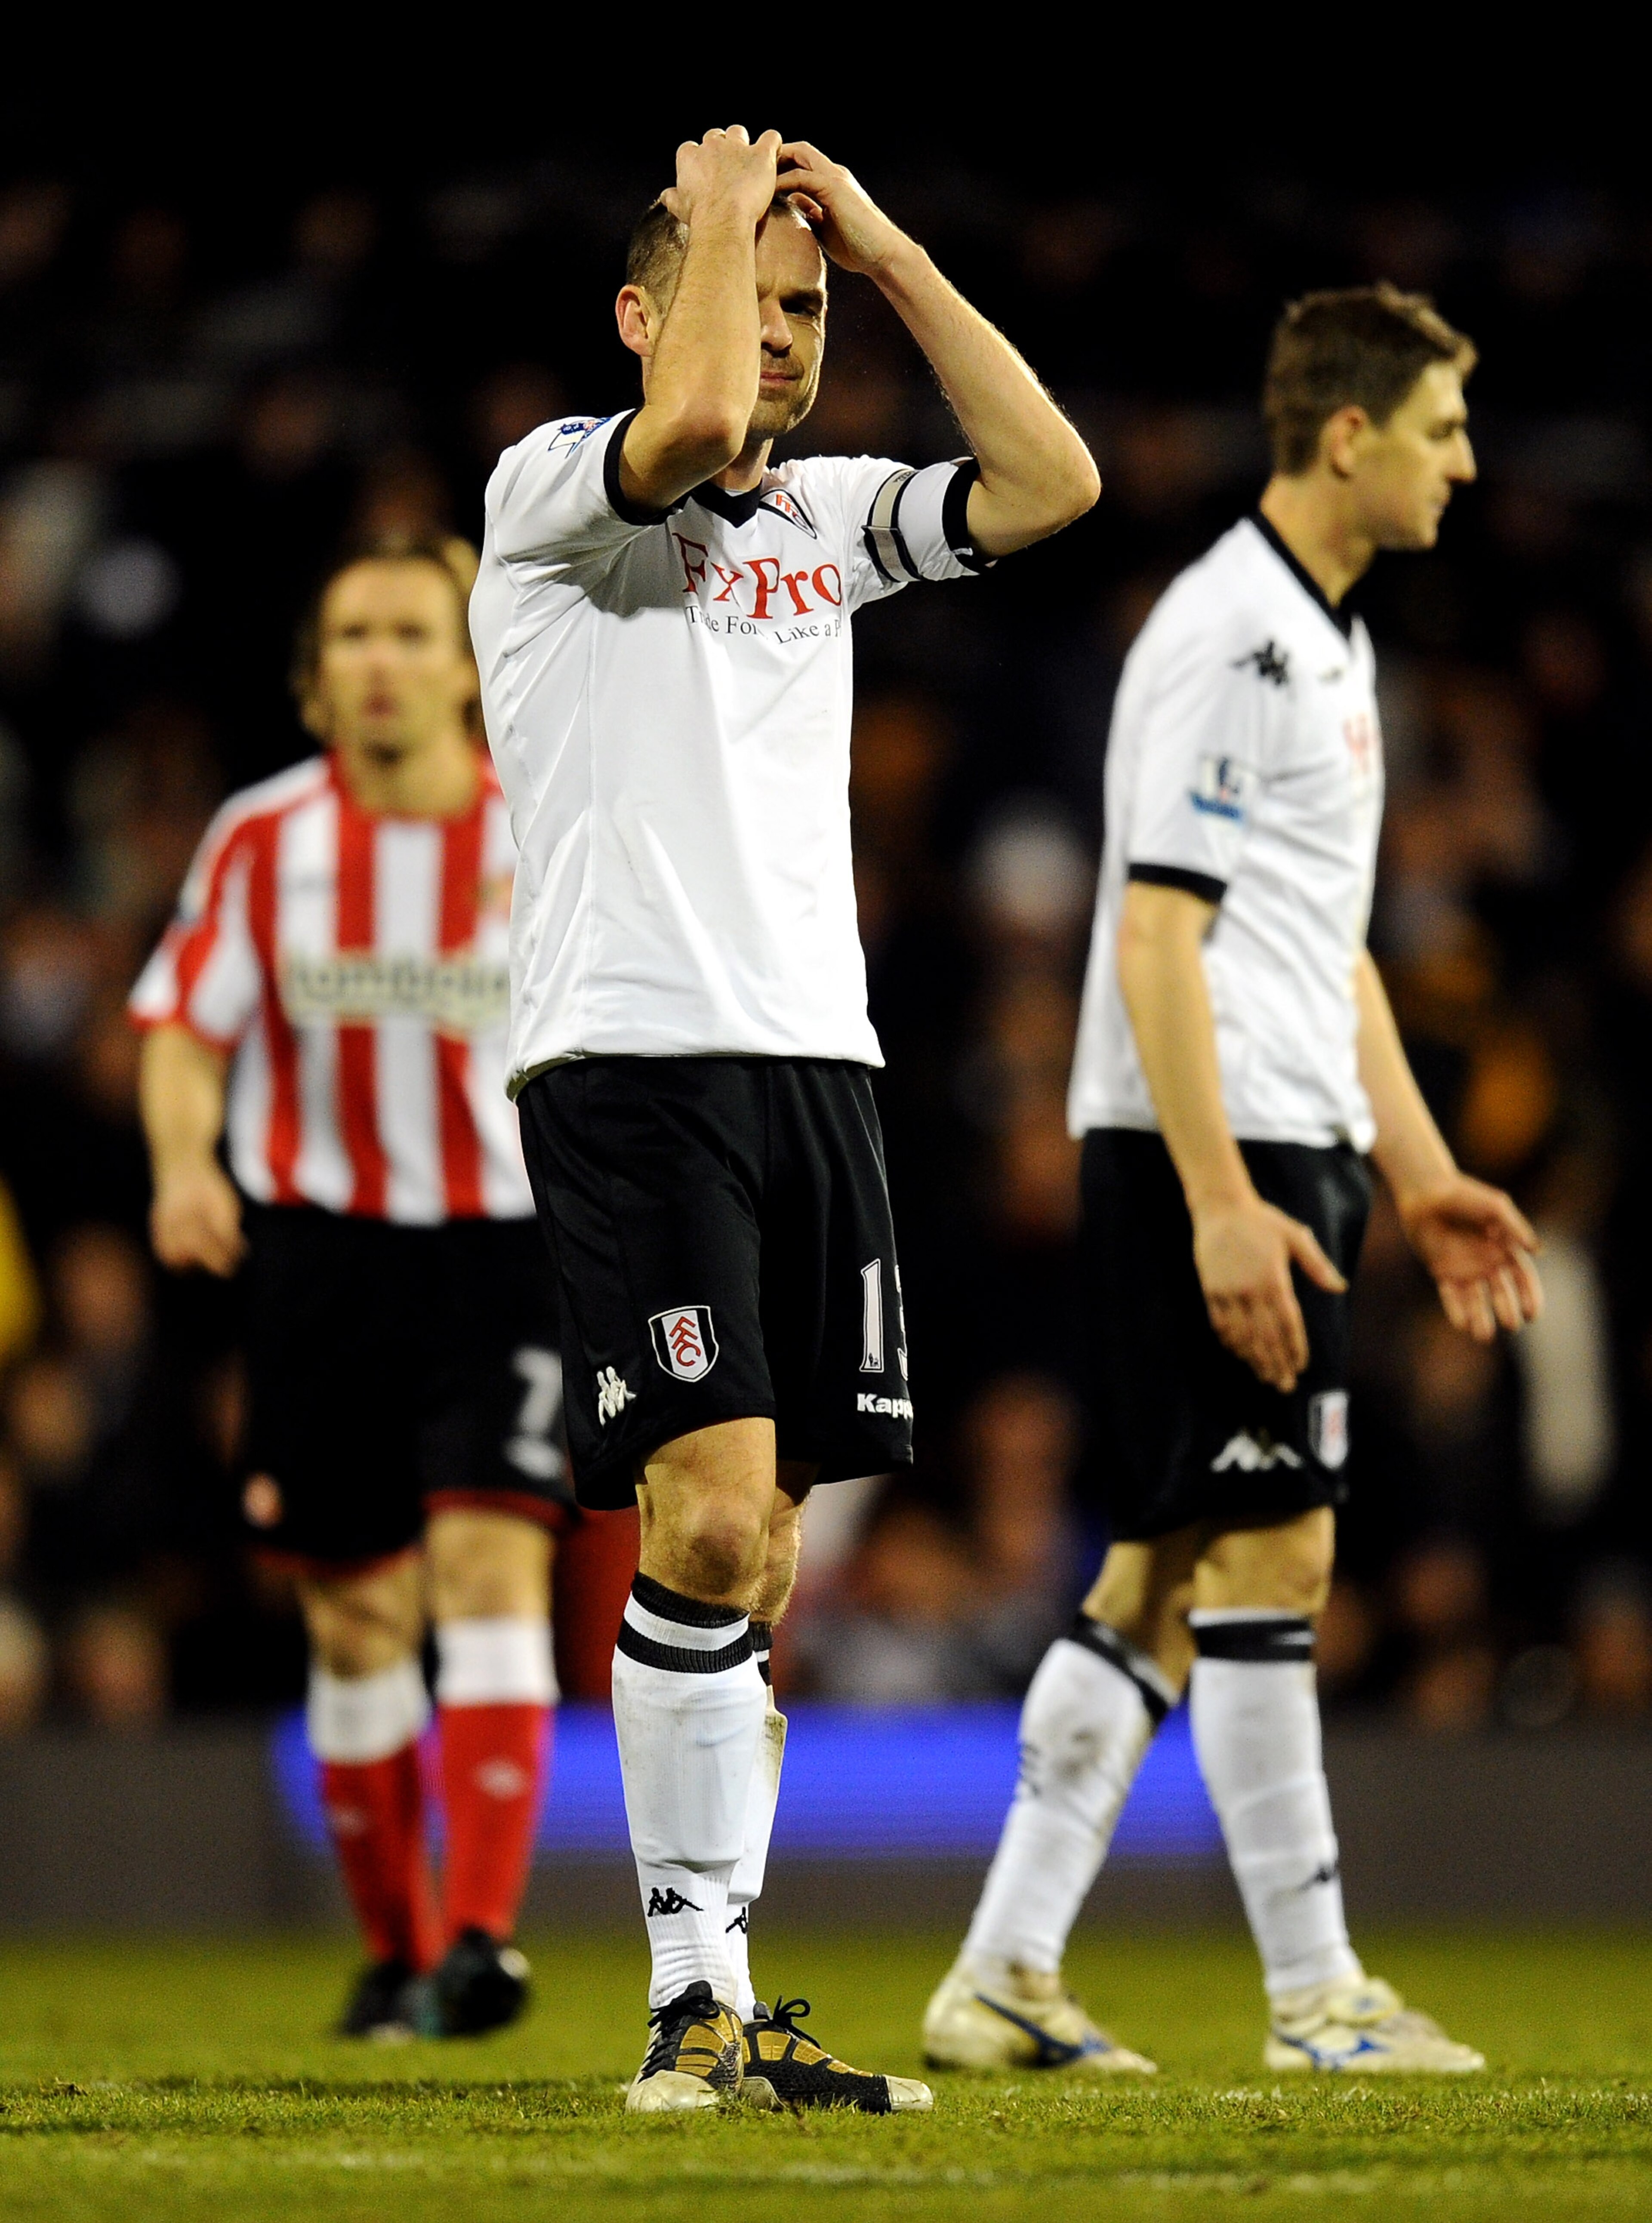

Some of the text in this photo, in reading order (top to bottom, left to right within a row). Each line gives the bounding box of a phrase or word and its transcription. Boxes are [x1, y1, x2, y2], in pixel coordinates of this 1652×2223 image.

[672, 533, 841, 619] FxPro
[774, 626, 819, 644] Like
[824, 623, 831, 637] a
[669, 1316, 701, 1367] FFC
